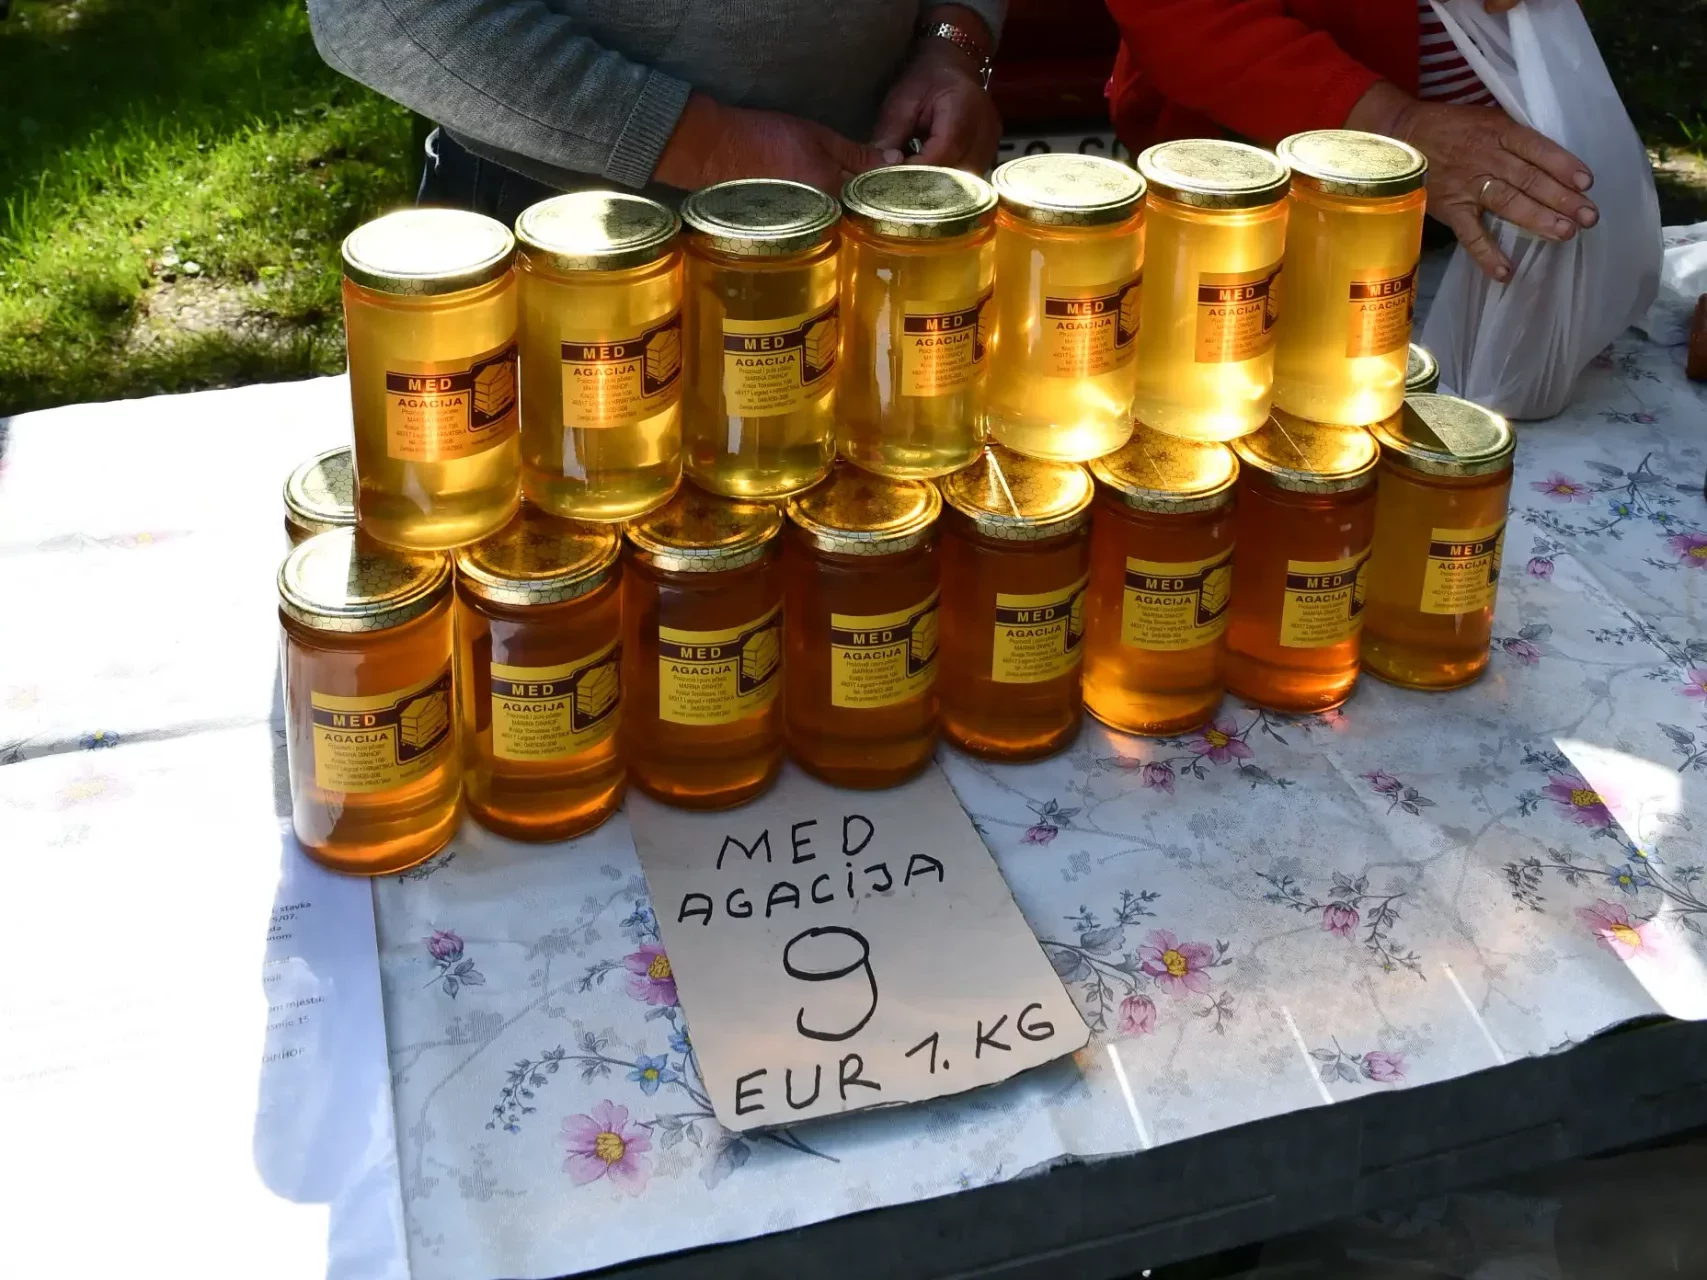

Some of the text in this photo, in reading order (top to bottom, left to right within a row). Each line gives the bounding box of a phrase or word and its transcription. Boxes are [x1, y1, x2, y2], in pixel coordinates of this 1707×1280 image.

[1220, 287, 1254, 300] MED
[1370, 281, 1401, 297] MED
[1067, 302, 1104, 314] MED
[1208, 304, 1260, 316] AGACIJA
[1360, 297, 1406, 312] AGACIJA
[926, 316, 963, 330] MED
[1056, 318, 1111, 330] AGACIJA
[744, 337, 785, 350] MED
[916, 332, 970, 346] AGACIJA
[583, 346, 625, 359] MED
[736, 355, 796, 366] AGACIJA
[574, 364, 635, 376] AGACIJA
[408, 378, 452, 391] MED
[398, 397, 462, 408] AGACIJA
[1450, 544, 1483, 556] MED
[1438, 559, 1487, 570] AGACIJA
[1146, 578, 1184, 590] MED
[1307, 576, 1342, 588] MED
[1135, 595, 1192, 606] AGACIJA
[1296, 591, 1348, 603] AGACIJA
[1017, 608, 1055, 622] MED
[1006, 624, 1061, 637] AGACIJA
[853, 631, 892, 644] MED
[681, 647, 721, 659] MED
[843, 648, 902, 660] AGACIJA
[671, 665, 732, 675] AGACIJA
[512, 684, 554, 696] MED
[503, 702, 565, 712] AGACIJA
[332, 714, 376, 727] MED
[324, 733, 388, 744] AGACIJA
[717, 814, 874, 870] MED
[783, 926, 878, 1042] 9
[735, 1053, 881, 1116] EUR
[975, 1003, 1055, 1058] KG
